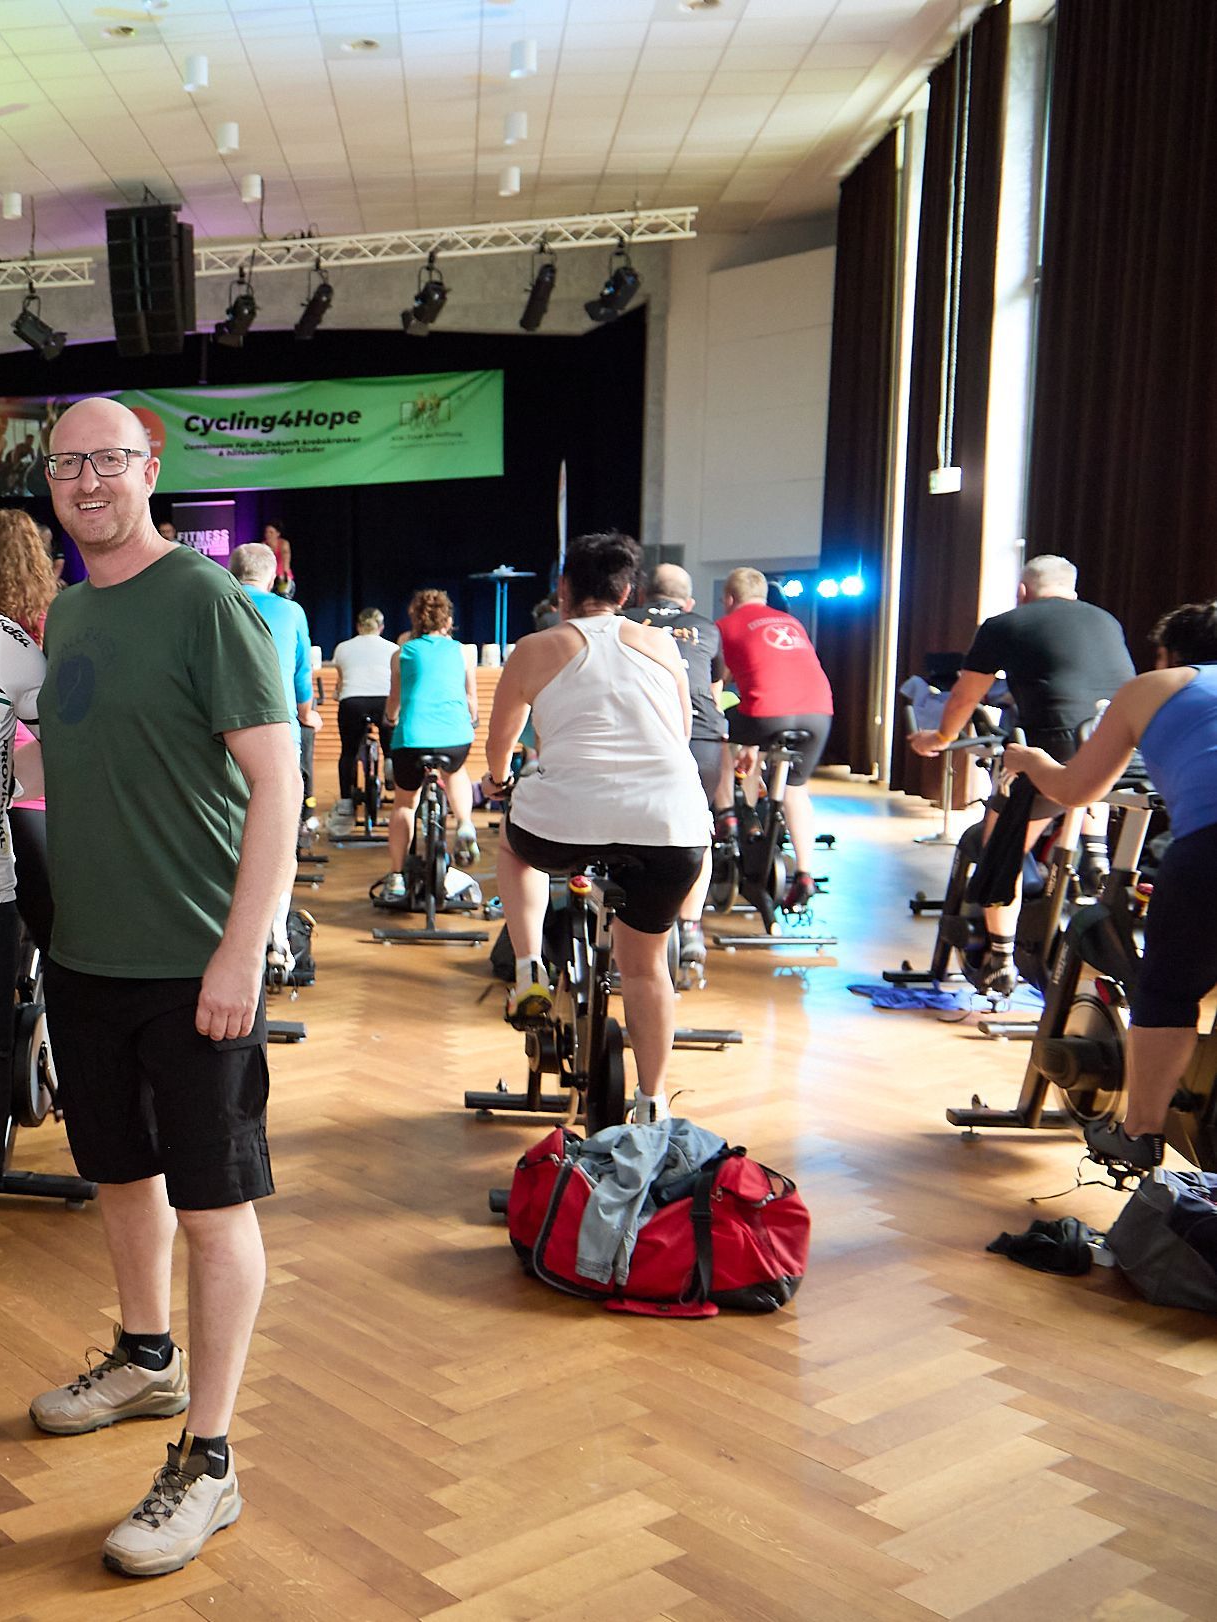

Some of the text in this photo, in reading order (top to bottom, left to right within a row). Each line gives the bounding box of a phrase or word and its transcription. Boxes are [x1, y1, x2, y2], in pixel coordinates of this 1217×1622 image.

[184, 409, 362, 436] Cycling4Hope
[250, 440, 263, 448] die
[177, 529, 229, 542] FITNESS
